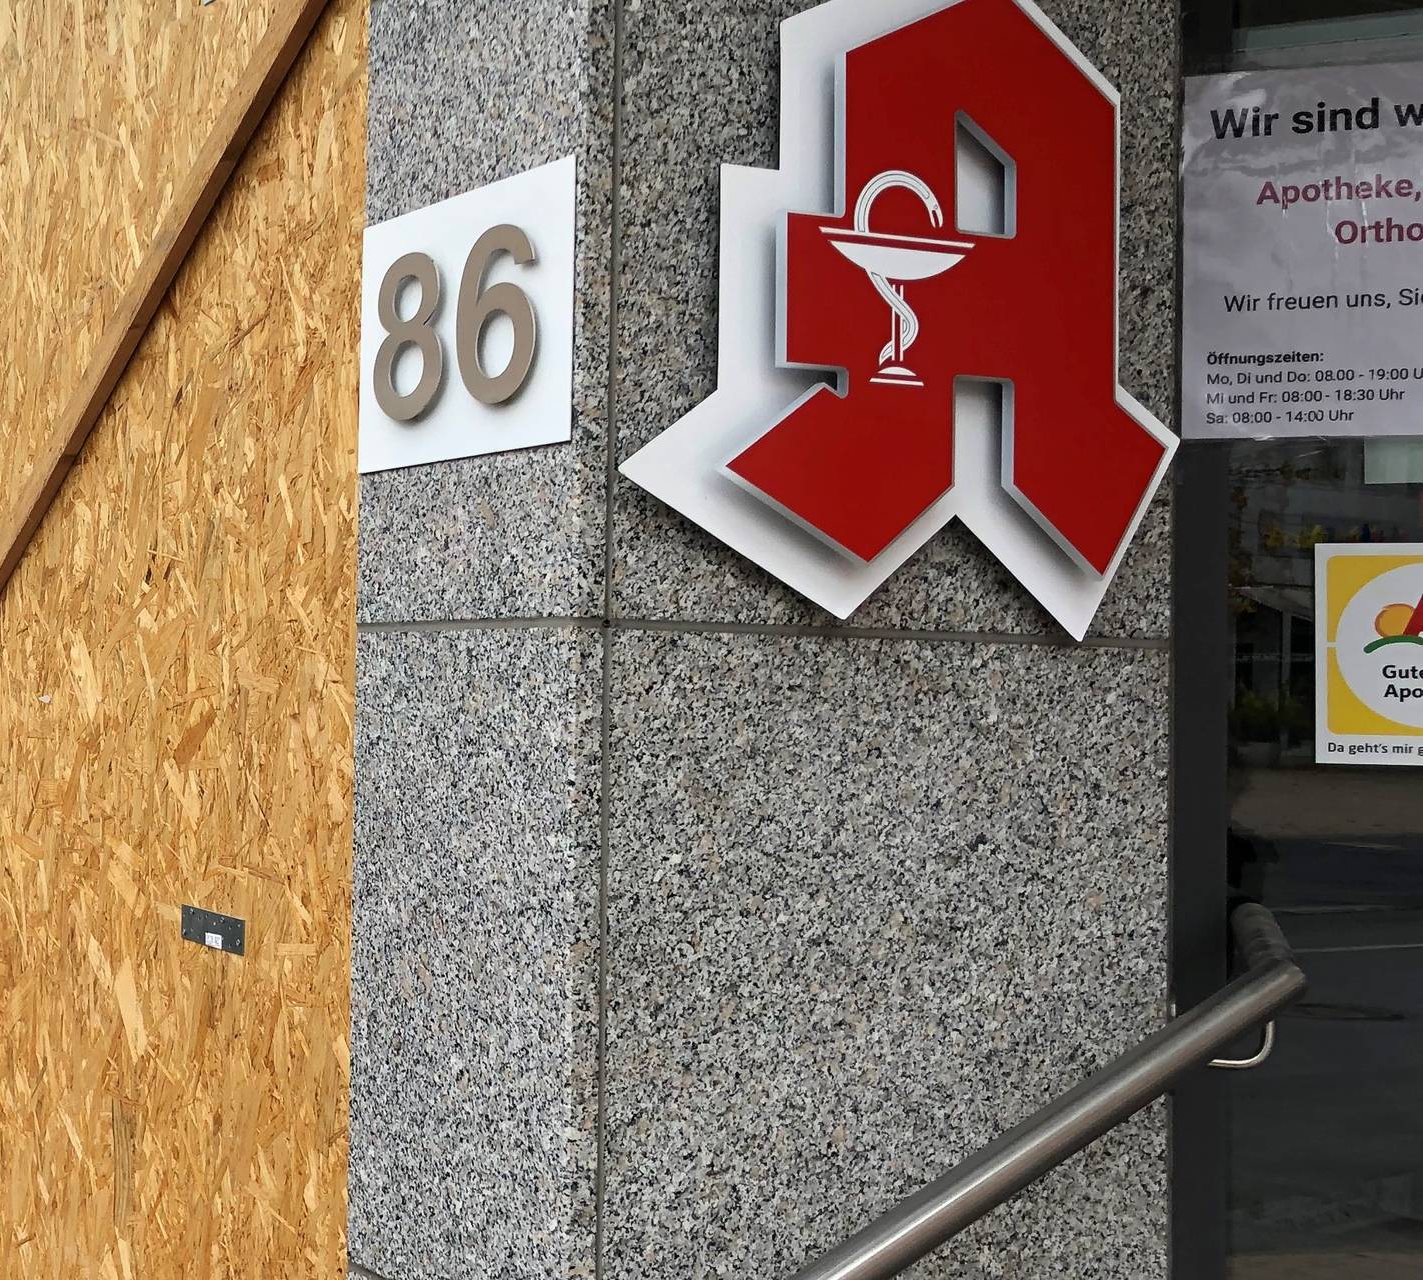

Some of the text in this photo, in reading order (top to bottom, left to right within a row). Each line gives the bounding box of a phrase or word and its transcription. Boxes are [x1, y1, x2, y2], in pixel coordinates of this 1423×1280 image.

[1210, 106, 1279, 139] Wir
[1292, 98, 1379, 133] sind
[1257, 174, 1421, 208] Apotheke,
[1334, 218, 1423, 245] Ortho
[1224, 288, 1423, 312] Wir freuen uns, Si
[373, 223, 537, 421] 86
[1206, 351, 1324, 367] Öffnungszeiten:
[1206, 373, 1233, 386] Mo,
[1237, 372, 1251, 384] Di
[1255, 371, 1283, 383] und
[1287, 371, 1311, 383] Do:
[1368, 368, 1409, 381] 19:00
[1206, 393, 1225, 405] Mi
[1228, 392, 1255, 404] und
[1259, 391, 1278, 404] Fr:
[1281, 390, 1323, 403] 08:00
[1335, 389, 1375, 402] 18:30
[1379, 388, 1405, 401] Uhr
[1206, 412, 1229, 424] Sa:
[1232, 411, 1272, 424] 08:00
[1286, 410, 1325, 423] 14:00
[1329, 409, 1355, 422] Uhr
[1383, 684, 1423, 703] Apo
[1327, 742, 1345, 753] Da
[1392, 743, 1414, 754] mir
